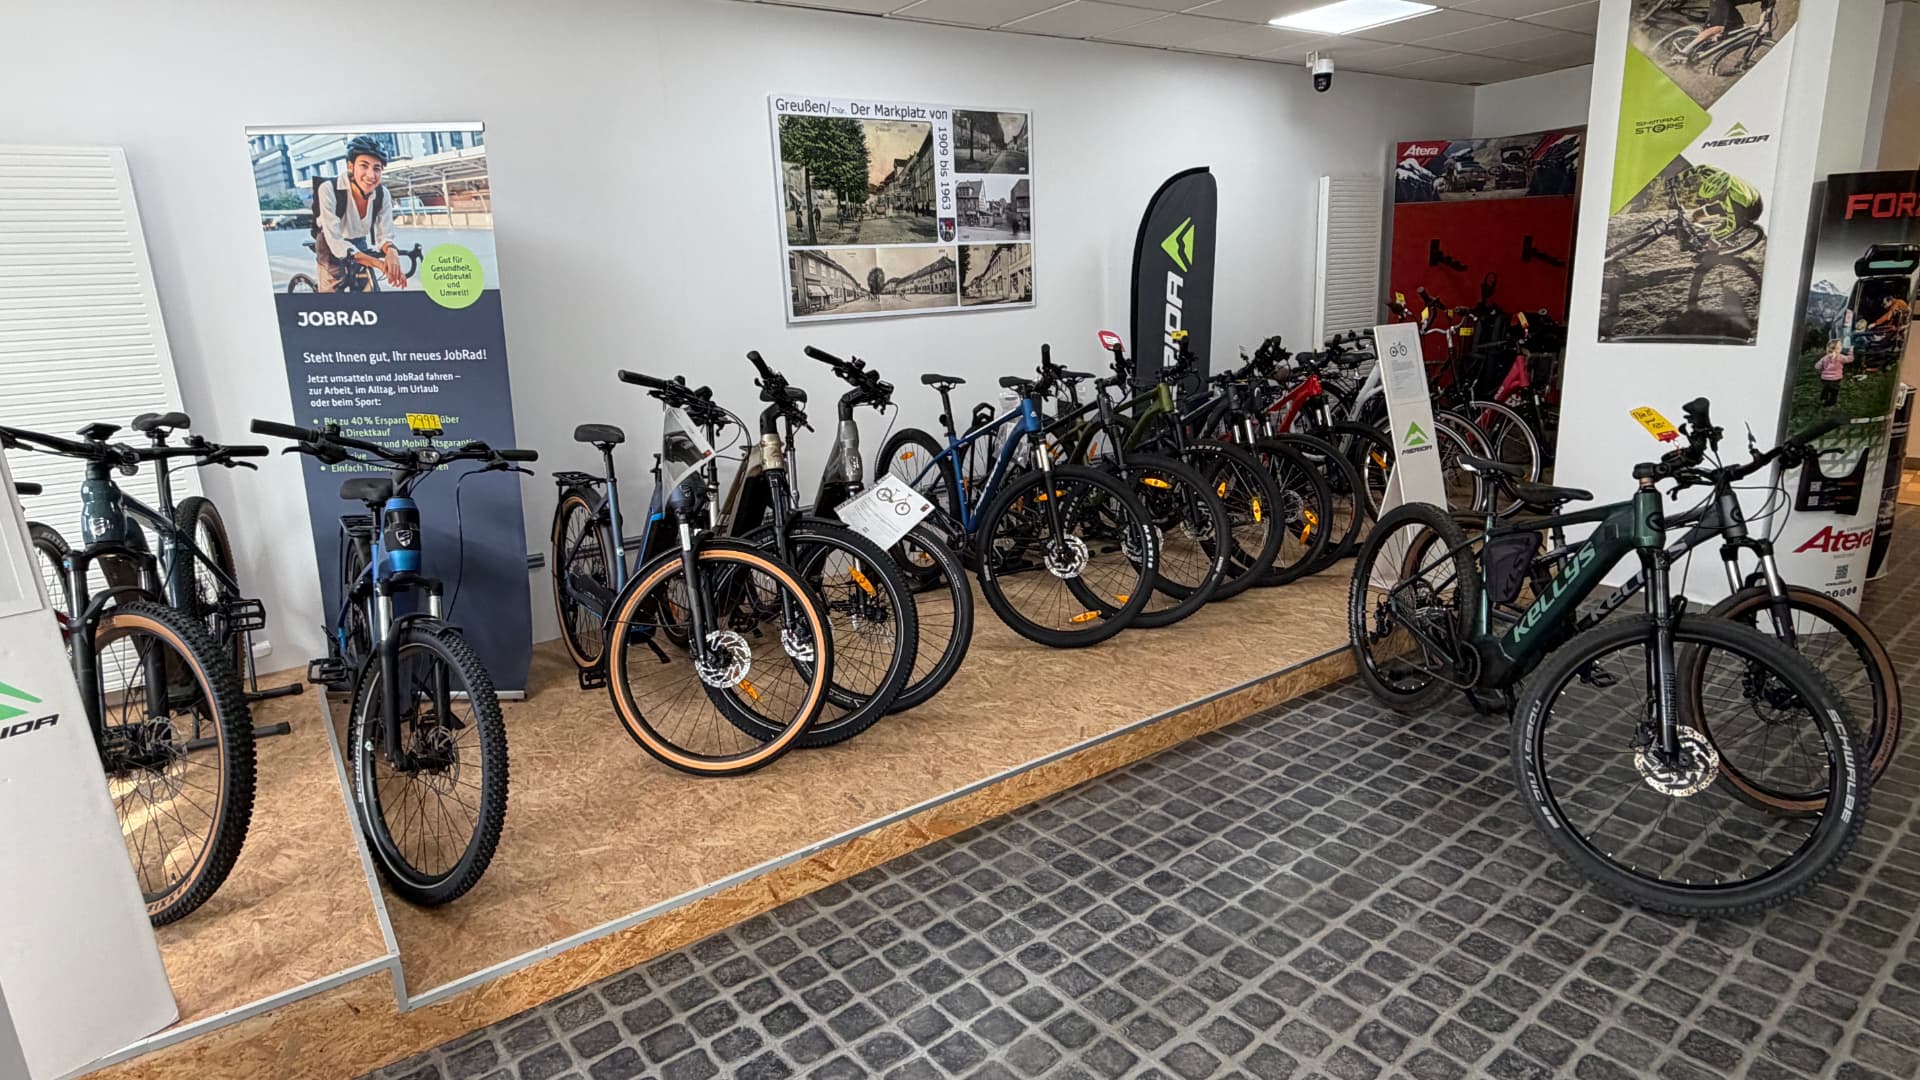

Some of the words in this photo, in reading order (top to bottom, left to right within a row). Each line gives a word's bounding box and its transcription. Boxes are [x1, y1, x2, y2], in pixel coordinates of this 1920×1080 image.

[850, 103, 870, 116] Der
[874, 104, 927, 121] Markplatz
[929, 110, 948, 120] von
[938, 127, 949, 157] 1909
[1701, 134, 1771, 149] MERIDA
[1403, 145, 1439, 157] Atera
[940, 160, 950, 177] bis
[941, 182, 952, 210] 1963
[438, 256, 451, 264] Gut
[452, 256, 463, 264] für
[447, 281, 461, 289] und
[297, 310, 378, 327] JOBRAD
[303, 351, 334, 364] Steht
[336, 351, 367, 363] Ihnen
[369, 352, 391, 365] gut,
[392, 350, 407, 362] Ihr
[409, 350, 442, 361] neues
[443, 349, 487, 361] JobRad!
[306, 374, 328, 384] Jetzt
[330, 373, 374, 383] umsatteln
[375, 372, 392, 382] und
[393, 372, 424, 382] JobRad
[425, 372, 453, 381] fahren
[308, 387, 323, 396] zur
[324, 385, 353, 396] Arbeit,
[355, 386, 366, 395] im
[367, 385, 396, 396] Alltag,
[397, 385, 408, 394] im
[410, 384, 439, 394] Urlaub
[310, 399, 330, 408] oder
[332, 398, 354, 407] beim
[355, 397, 382, 409] Sport:
[339, 418, 350, 426] zu
[347, 428, 391, 438] Direktkauf
[384, 439, 400, 449] und
[1401, 444, 1433, 456] MERIDA
[331, 463, 363, 473] Einfach
[1792, 525, 1873, 553] Atera
[1826, 708, 1857, 824] SCHWALBE
